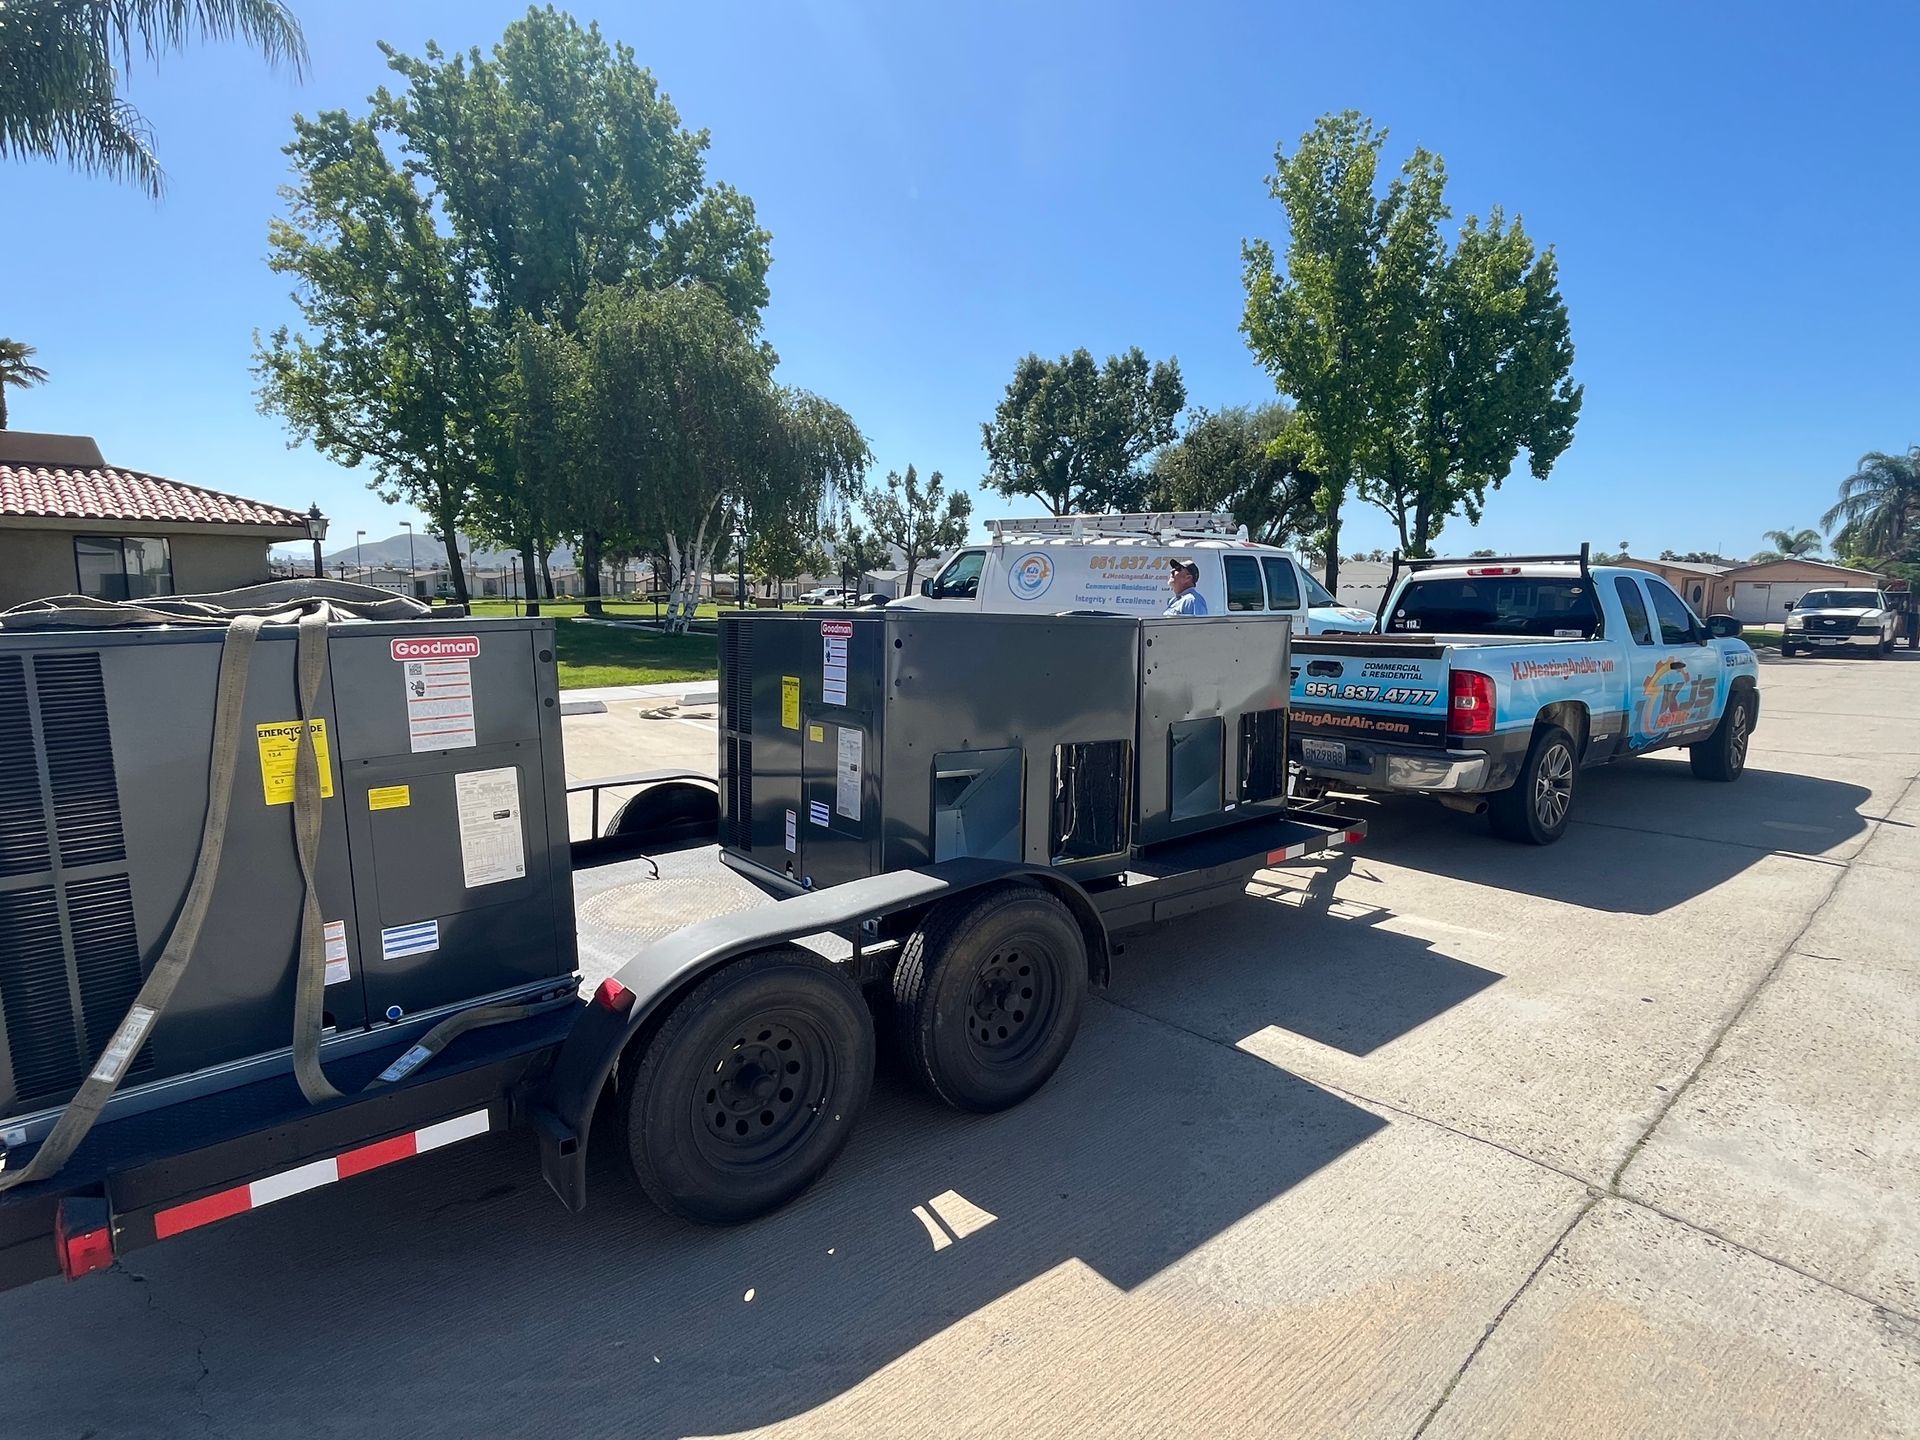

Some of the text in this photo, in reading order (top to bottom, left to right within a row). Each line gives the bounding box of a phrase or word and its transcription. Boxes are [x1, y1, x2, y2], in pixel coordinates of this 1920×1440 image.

[1089, 556, 1192, 570] 951.837.47
[1075, 594, 1106, 604] Integrity
[1116, 596, 1156, 605] Excellence
[822, 623, 851, 634] Goodman
[395, 641, 476, 655] Goodman
[1364, 662, 1421, 672] COMMERCIAL
[1369, 671, 1424, 680] RESIDENTIAL
[1305, 682, 1439, 706] 951.837.4777
[258, 724, 323, 738] ENERGYGDE
